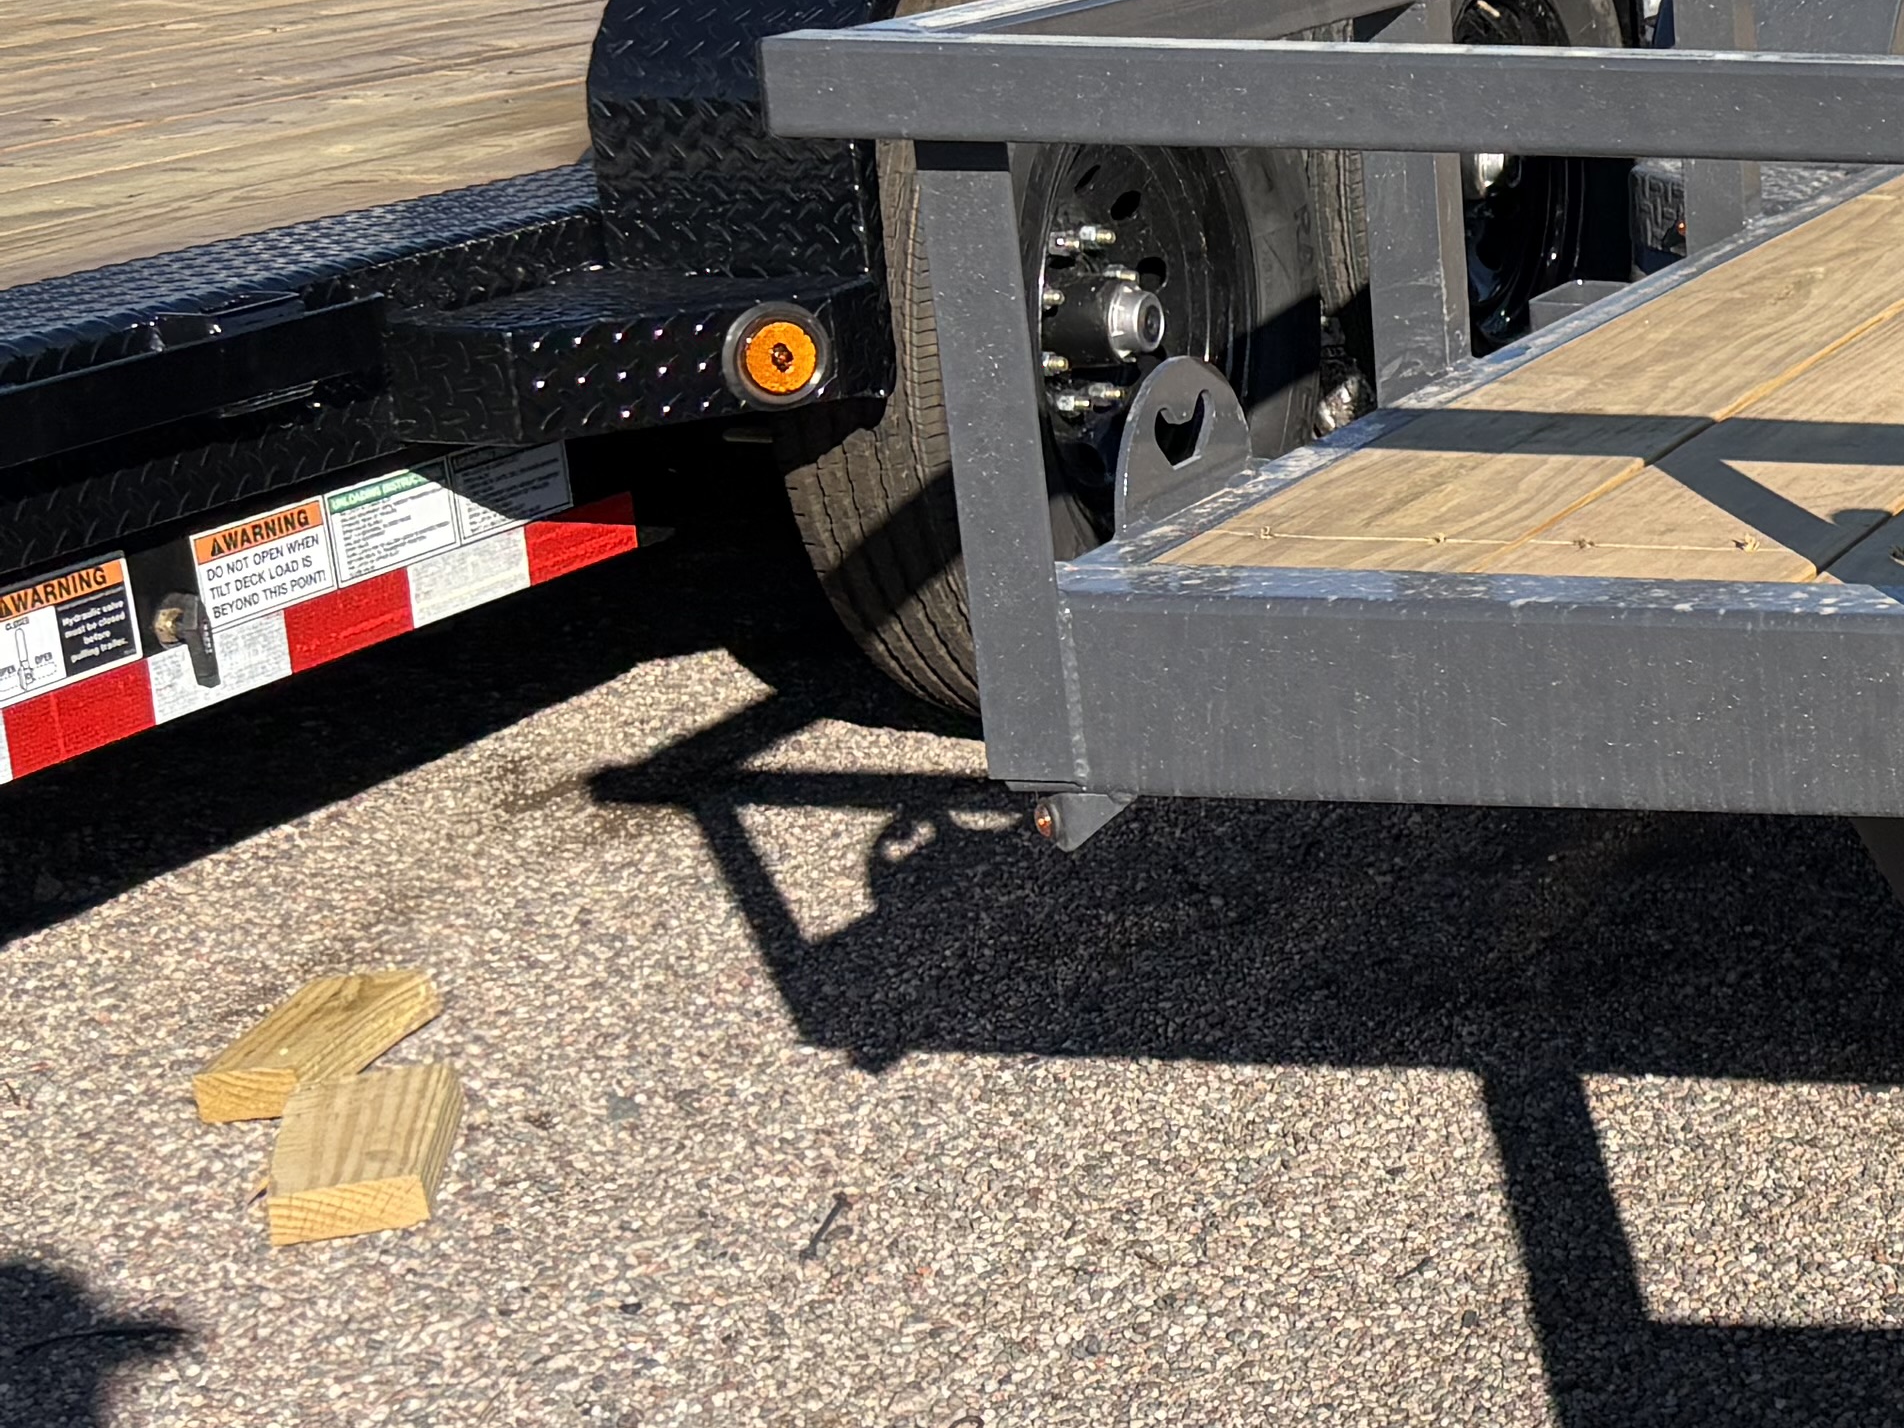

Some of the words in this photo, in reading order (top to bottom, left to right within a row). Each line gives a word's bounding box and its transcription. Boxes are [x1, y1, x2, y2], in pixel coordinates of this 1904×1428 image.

[221, 509, 310, 552] WARNING
[206, 565, 224, 581] DO
[226, 556, 249, 575] NOT
[253, 545, 284, 566] OPEN
[286, 534, 319, 555] WHEN
[209, 582, 232, 600] TILT
[234, 571, 267, 592] DECK
[268, 560, 299, 580] LOAD
[302, 555, 313, 568] IS
[10, 567, 107, 613] WARNING
[212, 592, 260, 619] BEYOND
[262, 582, 288, 601] THIS
[291, 569, 327, 592] POINT!
[62, 605, 101, 627] Hydraulic
